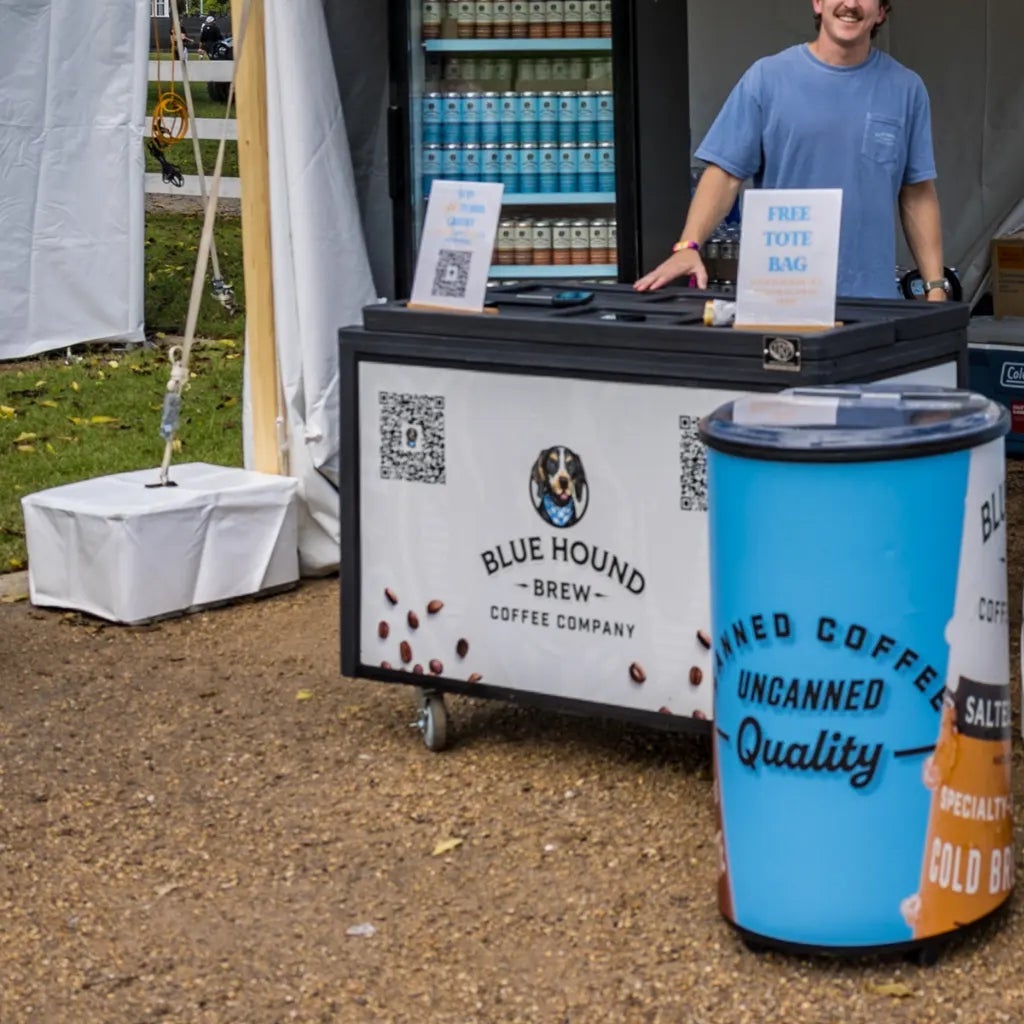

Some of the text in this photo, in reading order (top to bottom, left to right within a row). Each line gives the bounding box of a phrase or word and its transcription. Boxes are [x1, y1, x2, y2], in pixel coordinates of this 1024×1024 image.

[767, 205, 811, 222] FREE
[763, 230, 813, 247] TOTE
[768, 256, 808, 273] BAG
[481, 536, 646, 595] BLUE HOUND
[533, 578, 591, 602] BREW
[490, 605, 635, 639] COFFEE COMPANY
[715, 613, 791, 676] ANNED
[738, 669, 884, 711] UNCANNED
[737, 716, 884, 789] Quality
[929, 836, 982, 895] COLD
